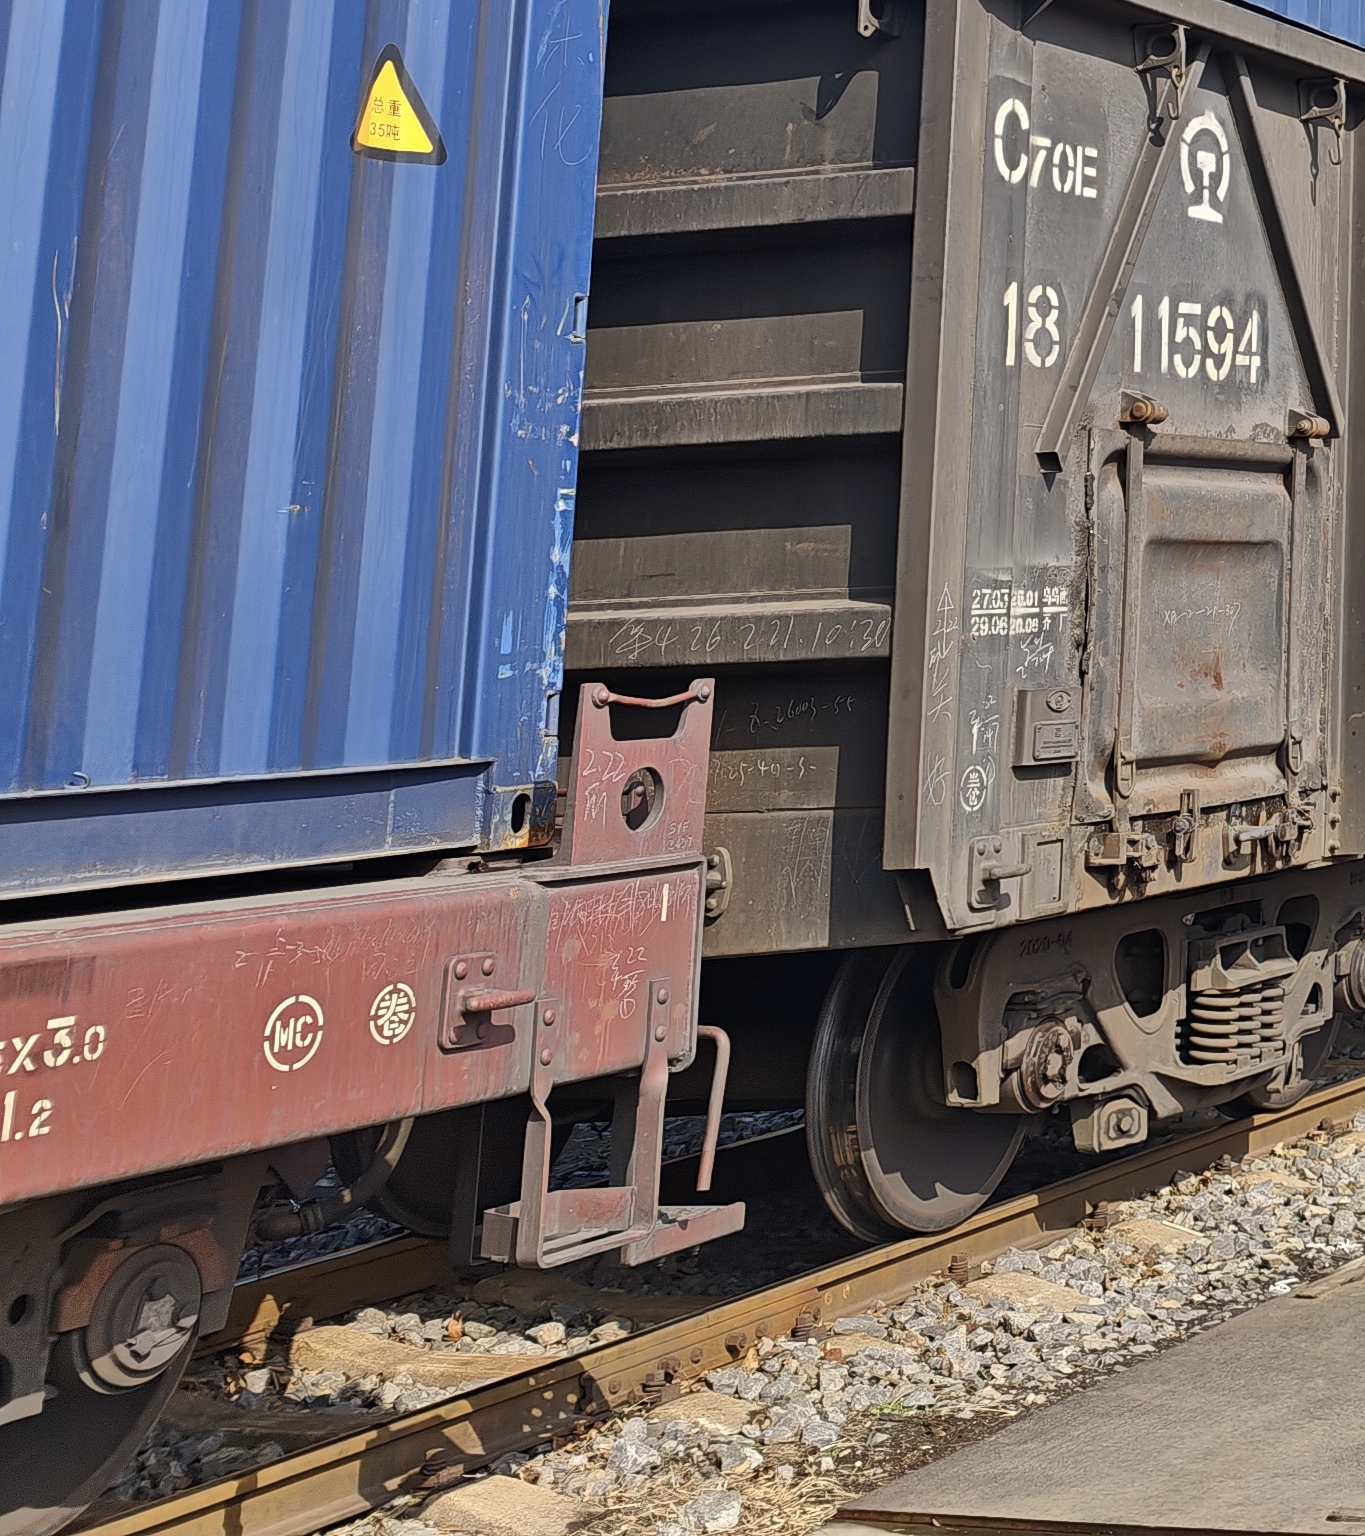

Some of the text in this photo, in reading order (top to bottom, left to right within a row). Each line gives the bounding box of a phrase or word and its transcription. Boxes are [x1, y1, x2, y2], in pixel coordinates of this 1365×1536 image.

[1003, 280, 1261, 384] 18 11594
[273, 1014, 314, 1053] MC
